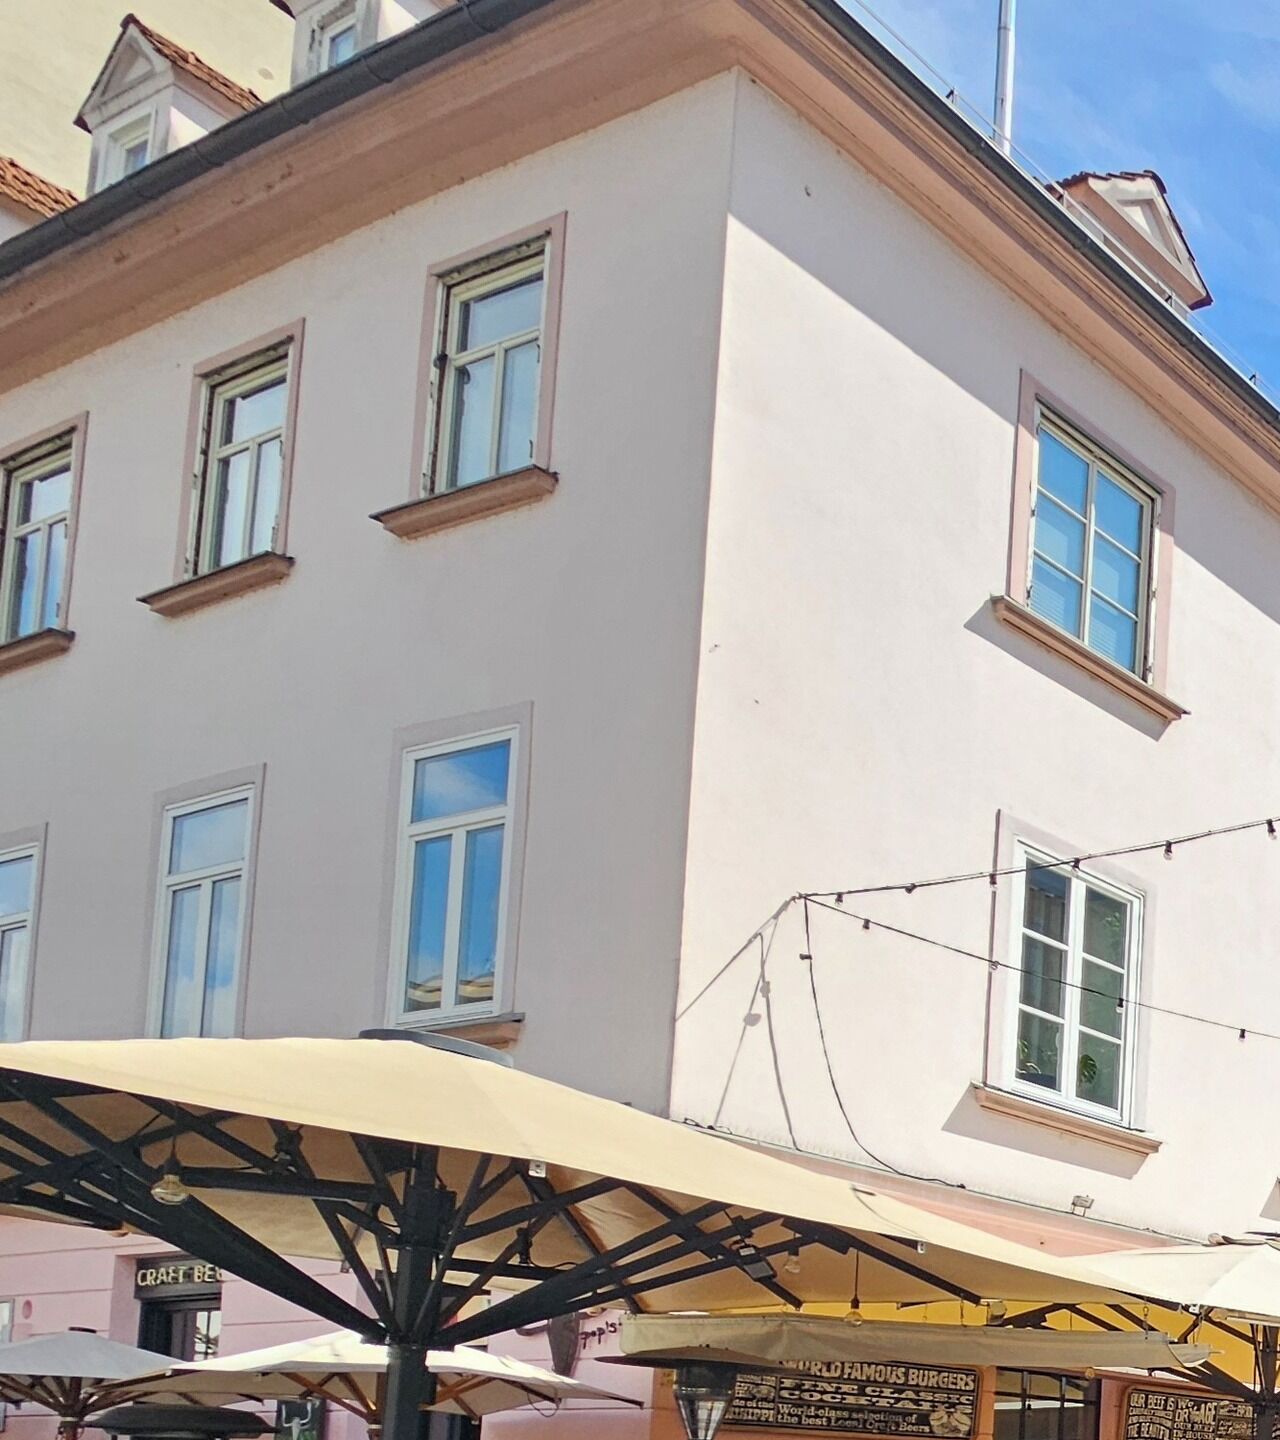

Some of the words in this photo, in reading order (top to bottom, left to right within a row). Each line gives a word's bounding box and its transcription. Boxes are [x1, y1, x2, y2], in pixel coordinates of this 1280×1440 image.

[137, 1266, 189, 1287] CRAFT
[843, 1361, 905, 1384] FAMOUS
[907, 1368, 974, 1391] BURGERS
[780, 1379, 858, 1394] FINE
[864, 1386, 973, 1404] CLASSIC
[780, 1389, 973, 1414] COCKTAILS
[778, 1403, 849, 1418] World-class
[1147, 1395, 1166, 1410] BEEF
[1166, 1397, 1175, 1411] IS
[777, 1413, 799, 1424] the
[801, 1415, 828, 1426] best
[899, 1422, 930, 1433] Beers
